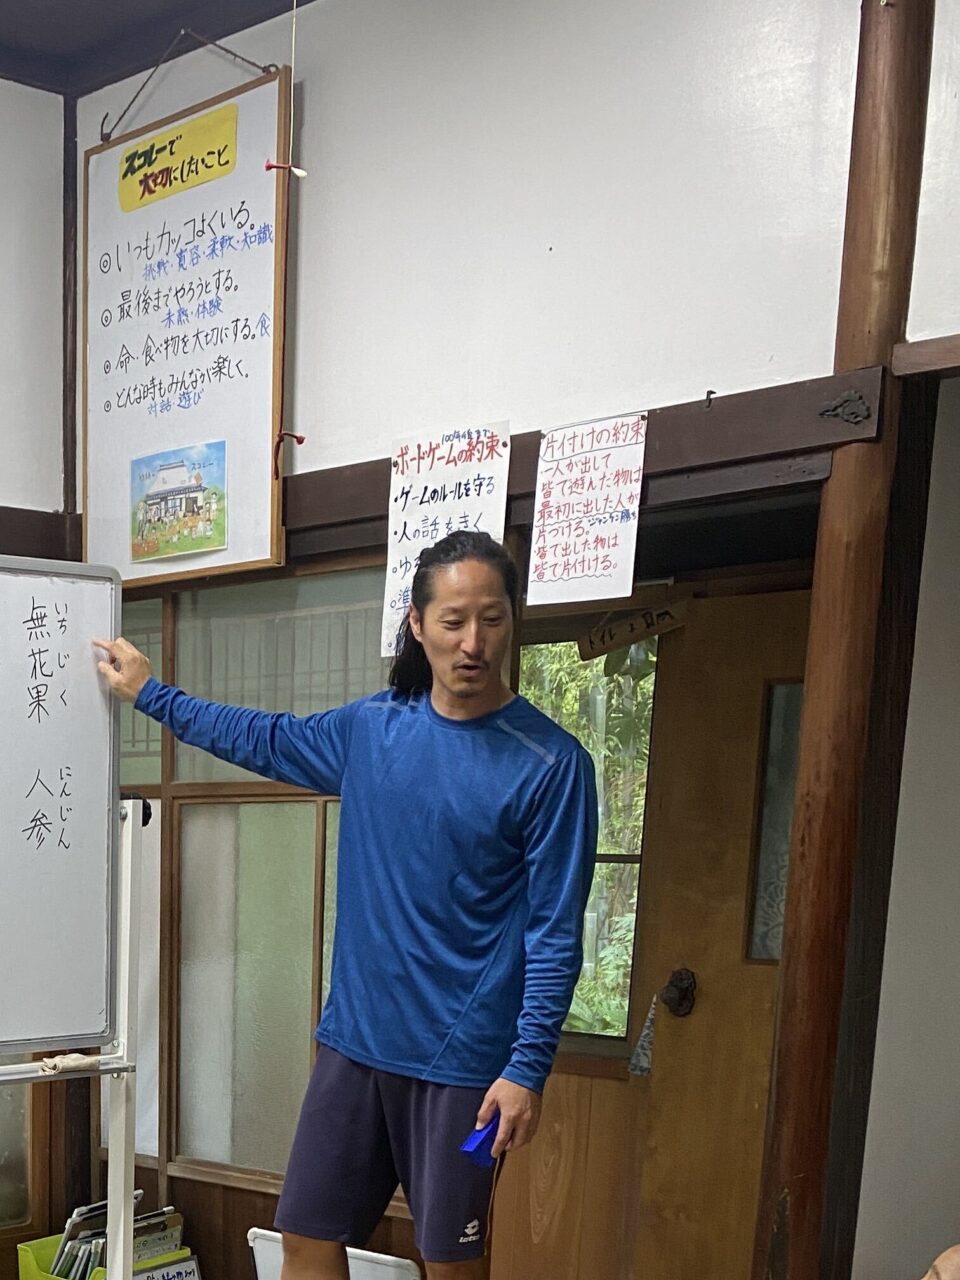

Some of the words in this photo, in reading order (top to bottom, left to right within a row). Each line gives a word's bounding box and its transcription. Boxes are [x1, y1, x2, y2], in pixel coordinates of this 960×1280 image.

[122, 134, 182, 180] スコレーで
[139, 144, 229, 201] 大切にしたいこと
[394, 431, 503, 475] ボードゲームの約束
[542, 417, 645, 459] 片付けの約束
[541, 466, 642, 499] 皆で遊んだ物は
[537, 492, 639, 525] 最初に出した人が
[21, 596, 55, 724] 無花果
[21, 768, 55, 850] 人参
[56, 766, 73, 849] にんじん
